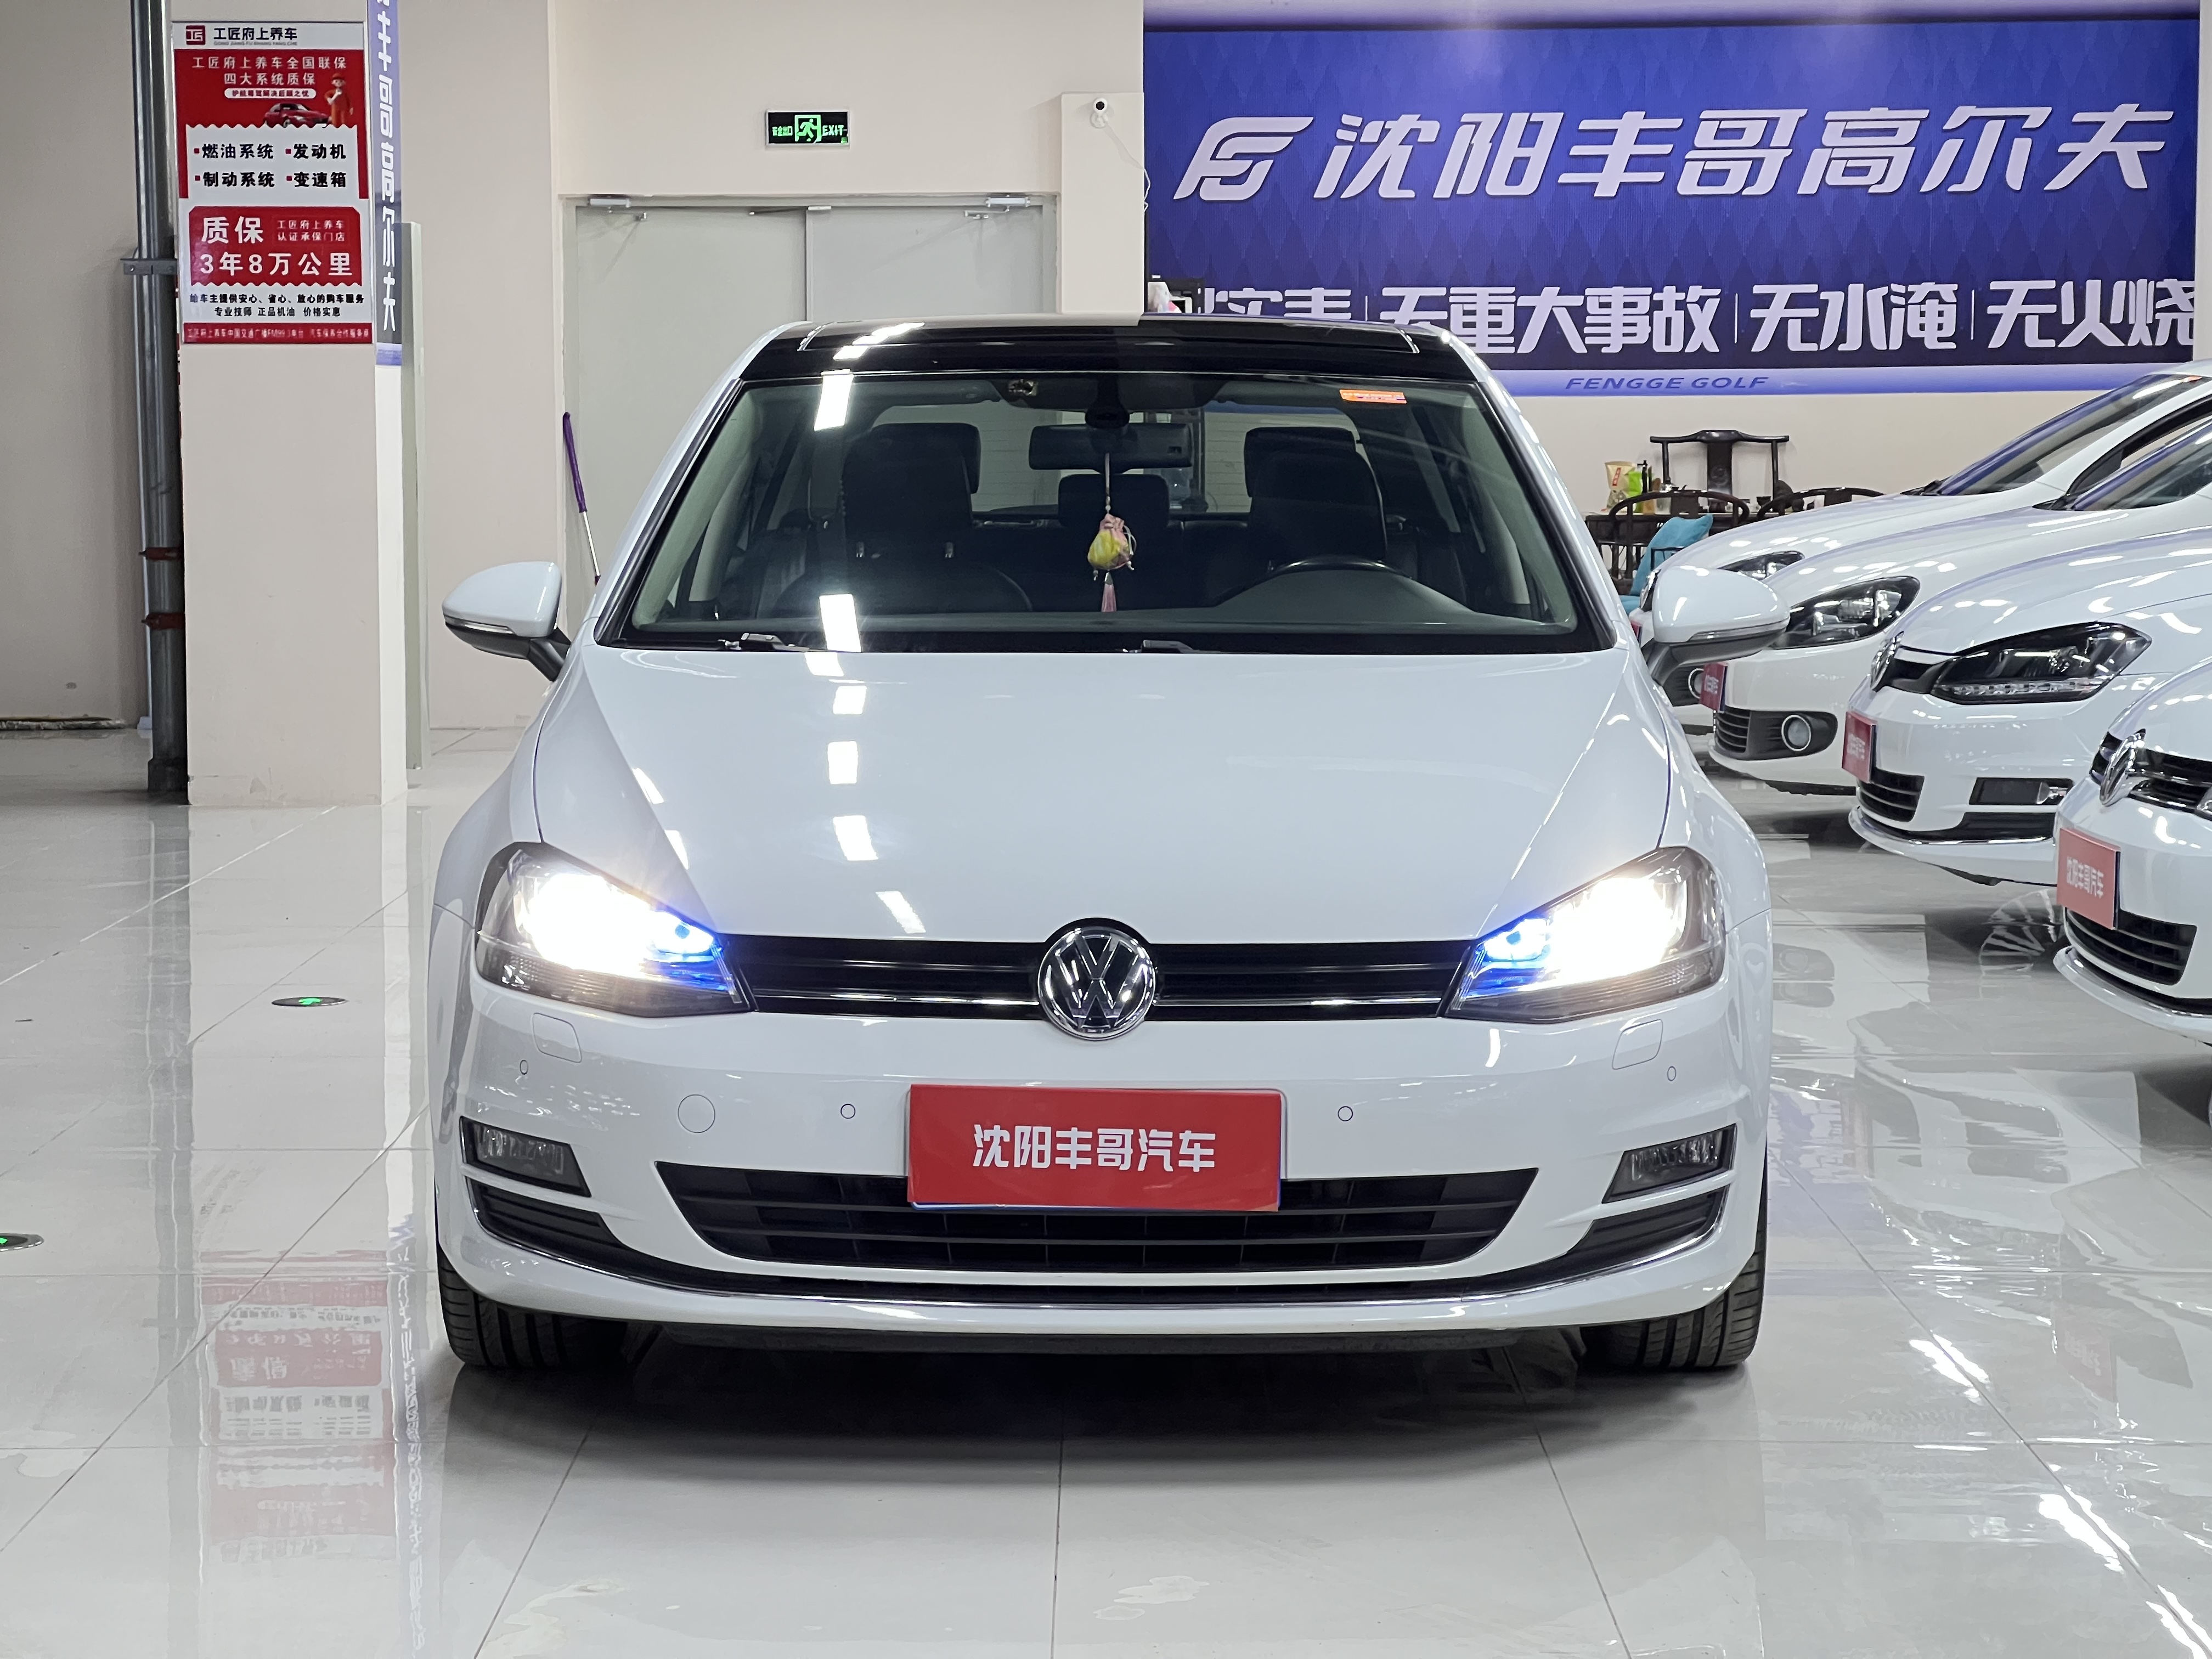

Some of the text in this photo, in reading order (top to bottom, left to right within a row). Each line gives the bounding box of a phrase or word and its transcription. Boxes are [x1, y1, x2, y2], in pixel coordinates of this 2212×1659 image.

[213, 27, 297, 40] 工匠府上养车
[192, 56, 346, 69] 工匠府上养车全国联保
[224, 72, 315, 85] 四大系统质保
[822, 125, 844, 137] EXIT
[201, 143, 346, 159] 燃油系统 发动机
[1313, 103, 2174, 199] 沈阳丰哥高尔夫
[377, 0, 396, 332] 丰哥高尔夫
[202, 171, 347, 188] 制动系统 变速箱
[201, 216, 264, 244] 质保
[277, 220, 345, 229] 工匠府上养车
[277, 232, 345, 241] 认证承保门店
[200, 251, 353, 276] 3年8万公里
[215, 307, 341, 317] 专业技师 正品机油 价格实惠
[1750, 282, 1959, 352] 无水淹
[1987, 279, 2194, 348] 无火烧
[1565, 377, 1769, 390] FENGGE GOLF
[973, 1124, 1216, 1172] 沈阳丰哥汽车
